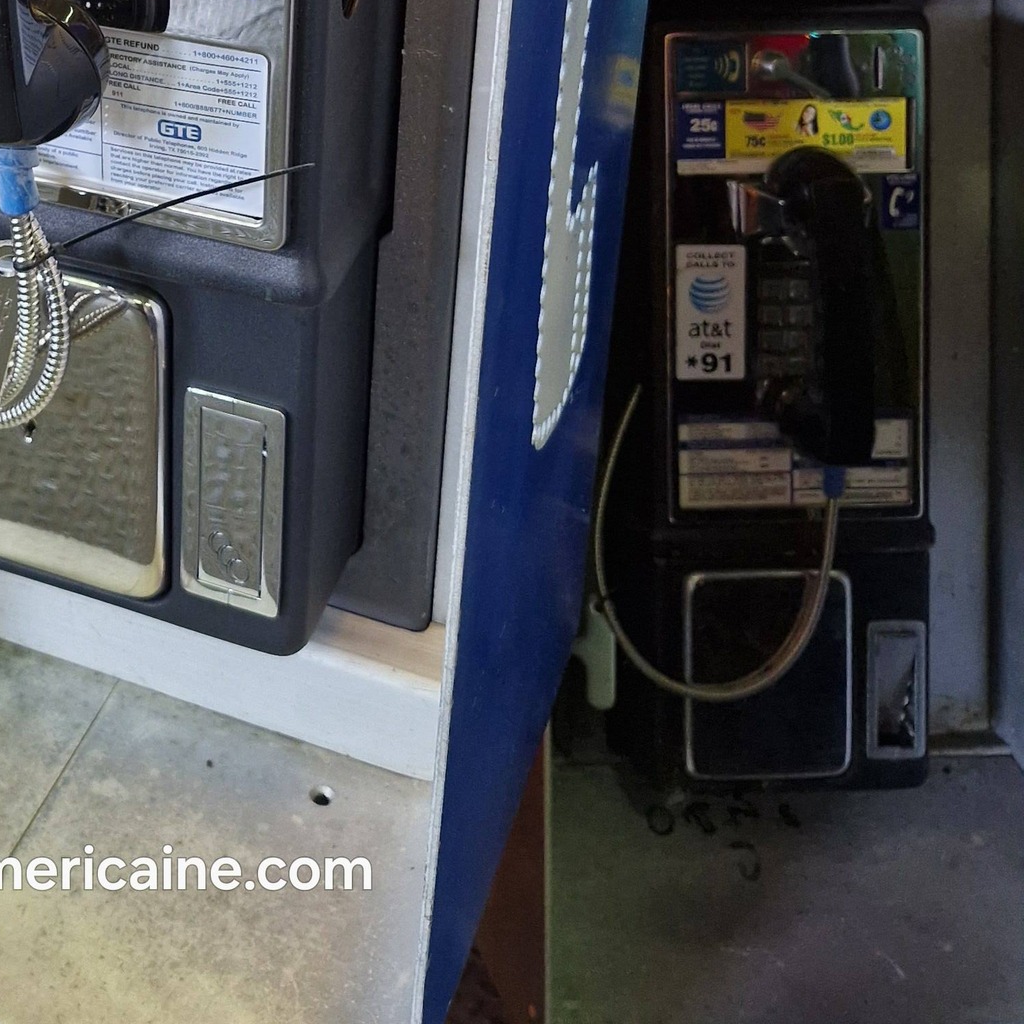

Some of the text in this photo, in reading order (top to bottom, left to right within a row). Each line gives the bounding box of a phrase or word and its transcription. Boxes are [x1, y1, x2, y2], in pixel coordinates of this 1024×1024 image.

[123, 39, 160, 52] REFUND
[142, 59, 187, 71] ASSISTANCE
[123, 82, 141, 92] CALL
[217, 97, 257, 110] FREE CALL
[159, 120, 200, 141] GTE
[688, 319, 733, 338] at&t
